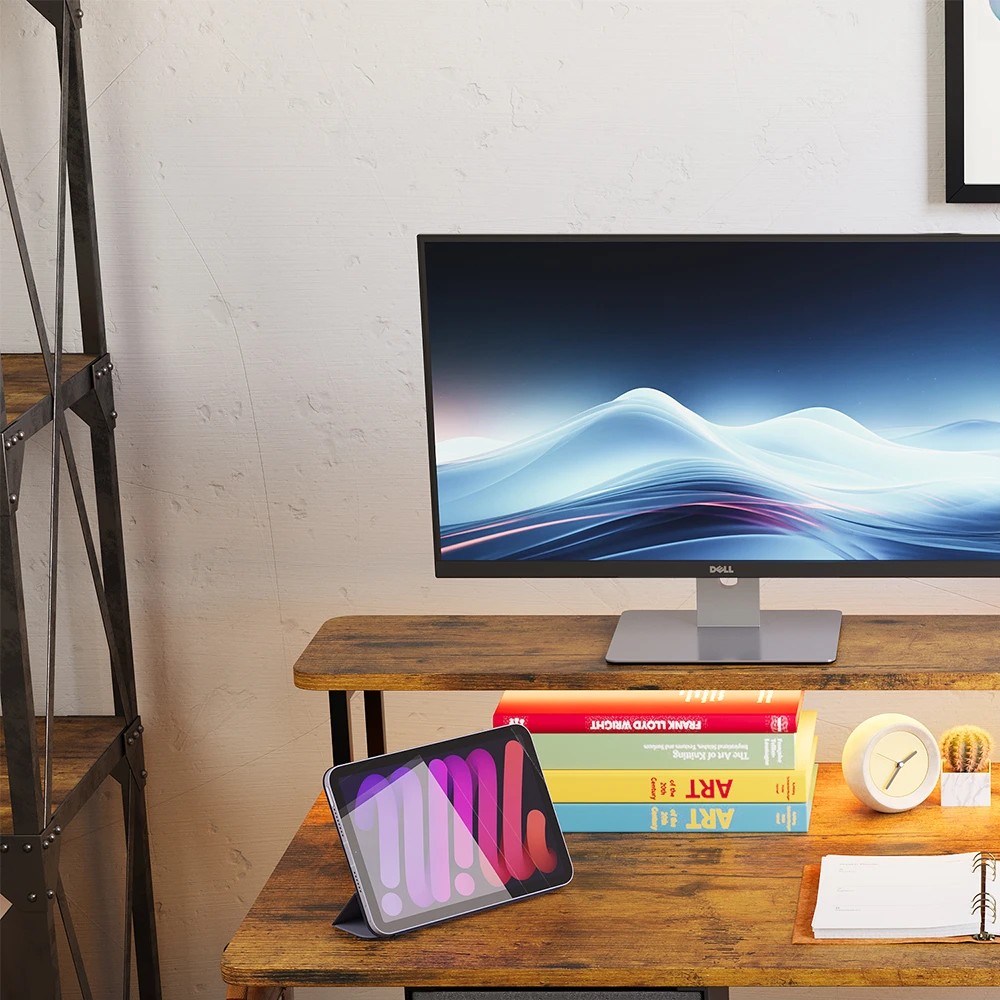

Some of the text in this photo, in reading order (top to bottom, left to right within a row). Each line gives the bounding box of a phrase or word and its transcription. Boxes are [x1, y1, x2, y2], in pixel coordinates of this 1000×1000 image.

[709, 565, 734, 574] DELL
[590, 719, 702, 731] FRANK LLOYD WRIGHT
[672, 749, 750, 761] The Art of Knitting
[649, 776, 658, 801] Century
[685, 779, 734, 799] ART
[685, 808, 735, 829] ART
